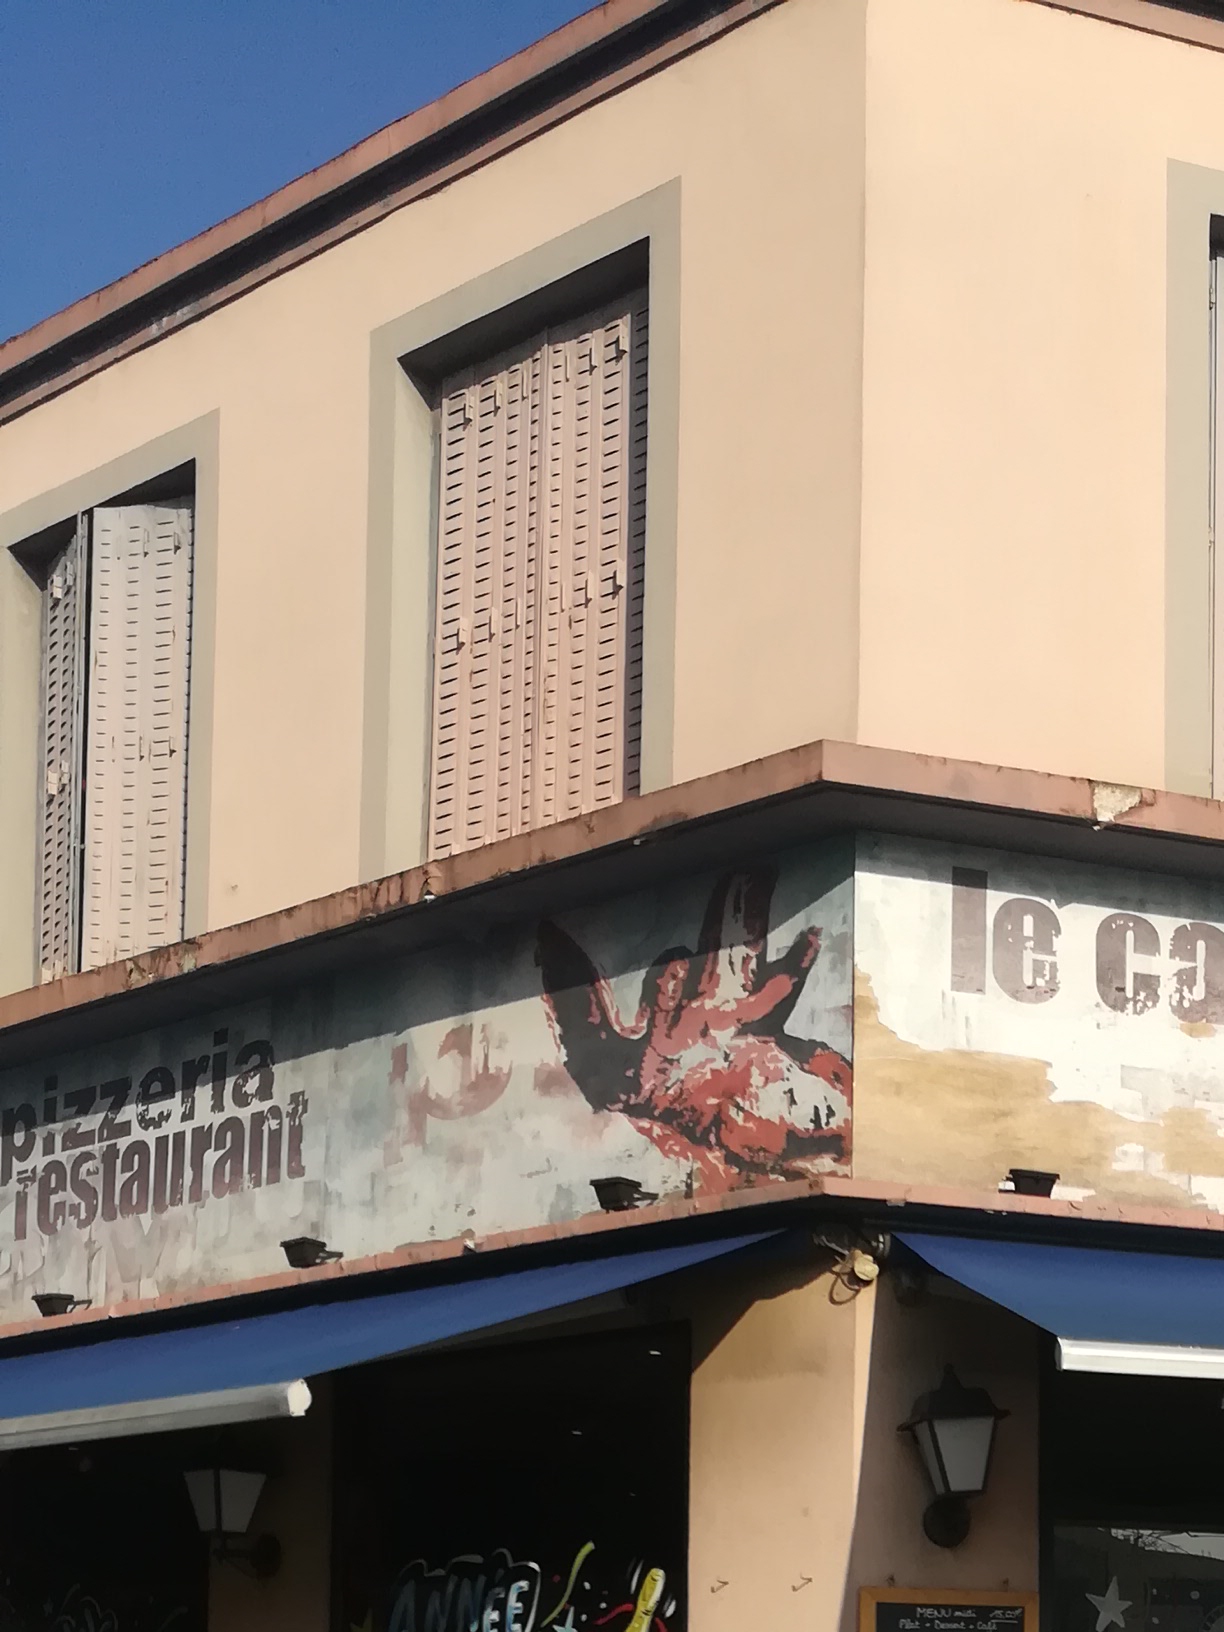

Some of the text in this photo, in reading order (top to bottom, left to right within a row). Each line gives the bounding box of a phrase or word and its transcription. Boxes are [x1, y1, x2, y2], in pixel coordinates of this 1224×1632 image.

[952, 866, 1062, 1004] le
[0, 1029, 274, 1187] pizzeria
[14, 1090, 308, 1241] restaurant
